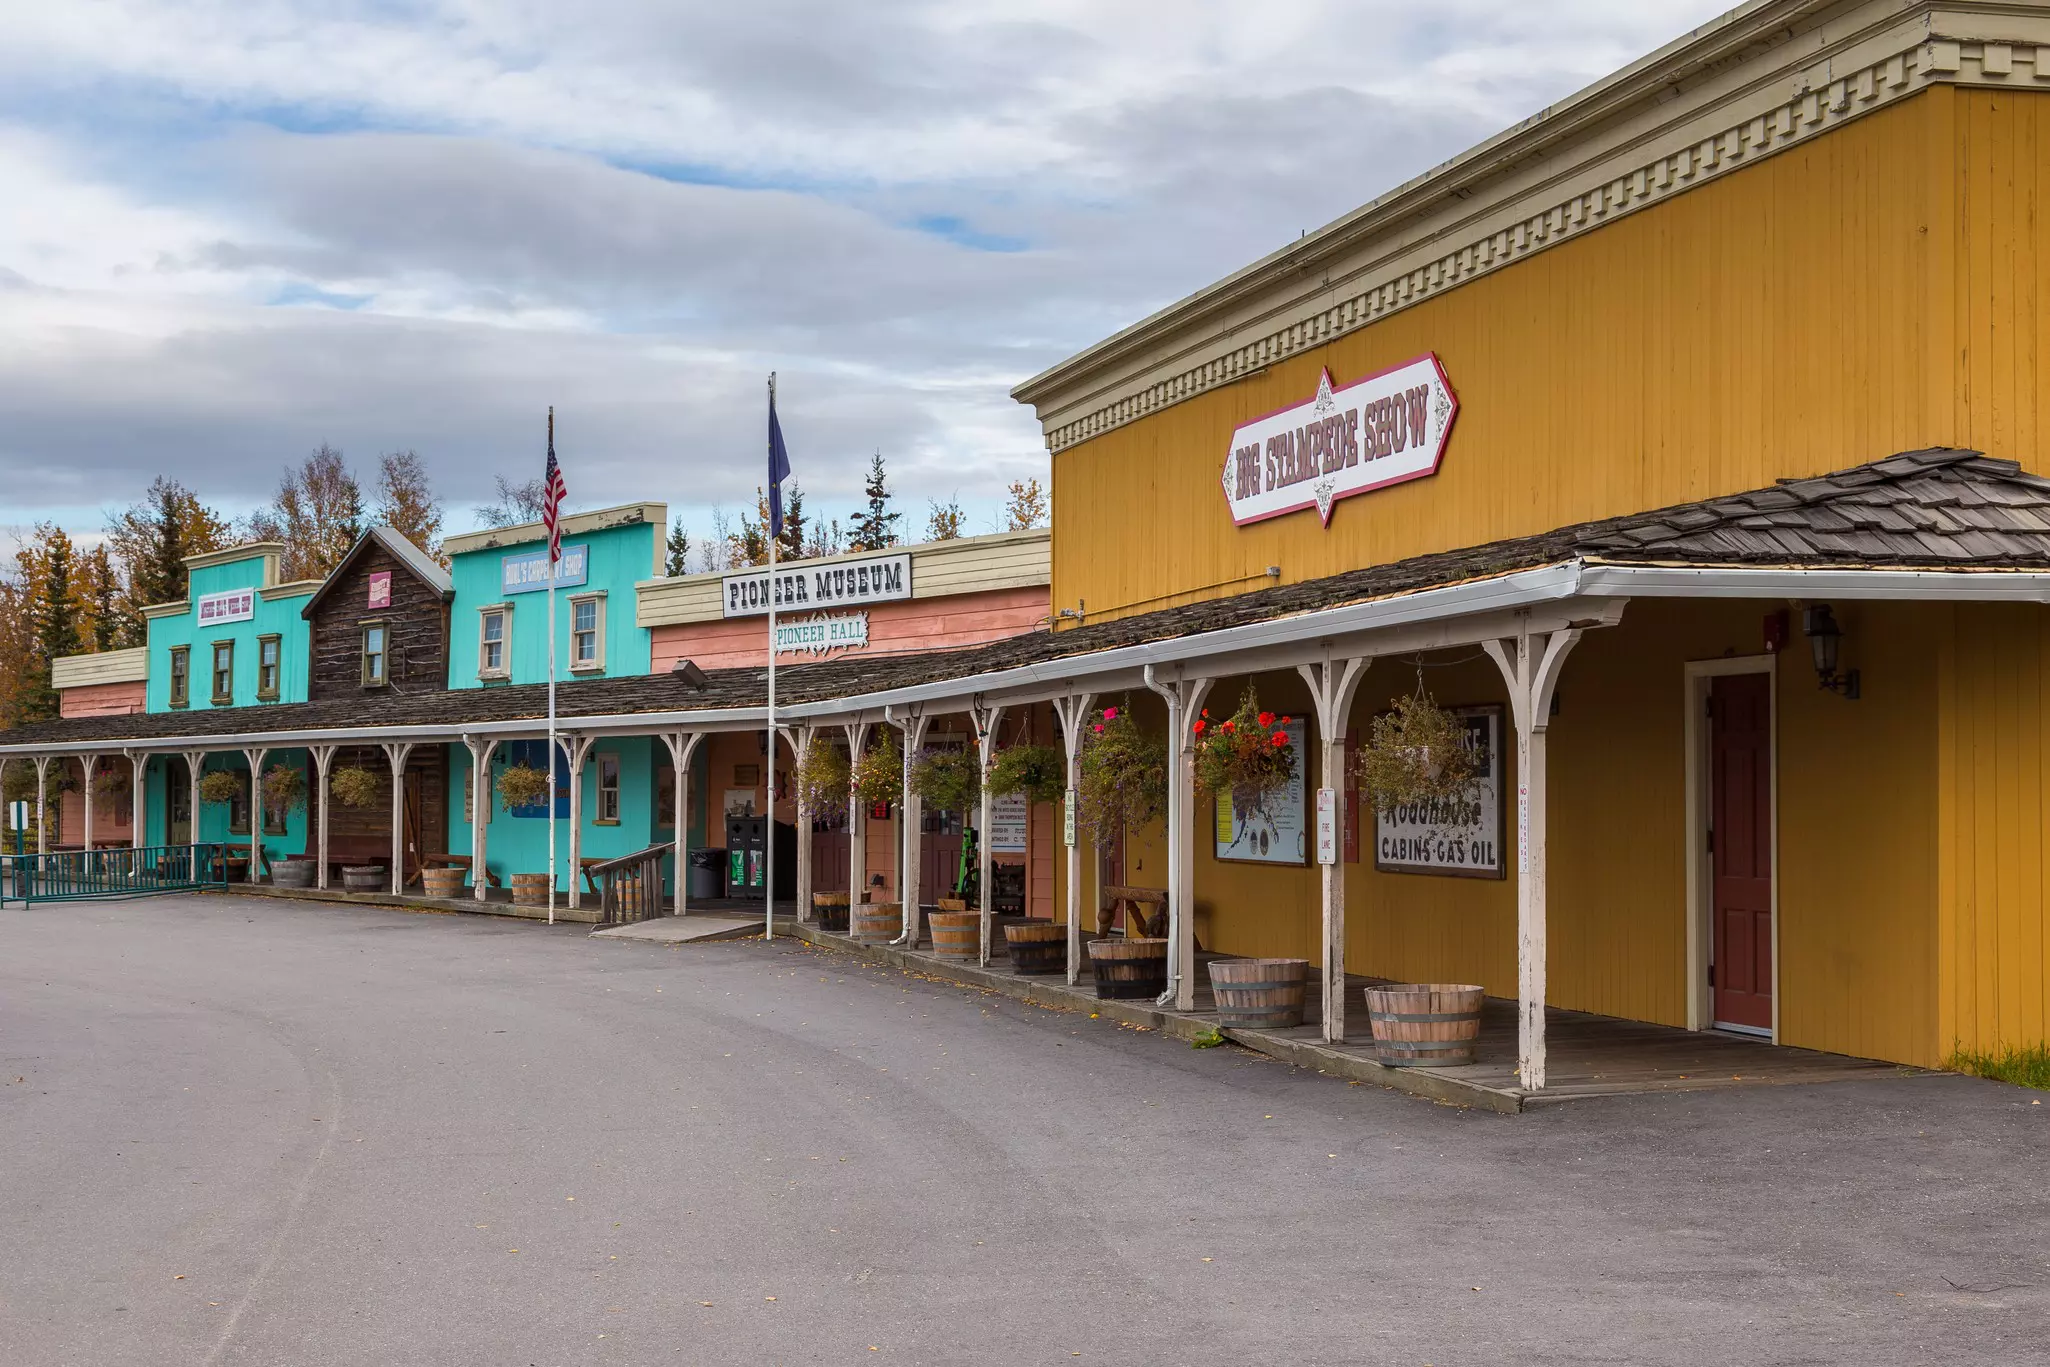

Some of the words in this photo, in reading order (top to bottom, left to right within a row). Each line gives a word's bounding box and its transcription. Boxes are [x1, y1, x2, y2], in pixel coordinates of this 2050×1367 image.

[1235, 442, 1261, 501] BIG
[1265, 408, 1358, 492] STAMPEDE
[1364, 383, 1429, 463] SHOW
[565, 554, 583, 577] SHOP
[729, 575, 809, 611] PIONEER
[815, 562, 903, 601] MUSEUM
[776, 624, 825, 646] PIONEER
[830, 621, 864, 640] HALL
[1519, 788, 1527, 796] NO
[1321, 822, 1330, 833] FIRE
[1321, 839, 1331, 850] LANE
[1382, 836, 1431, 862] CABINS
[1437, 840, 1465, 864] GAS
[1471, 840, 1496, 865] OIL
